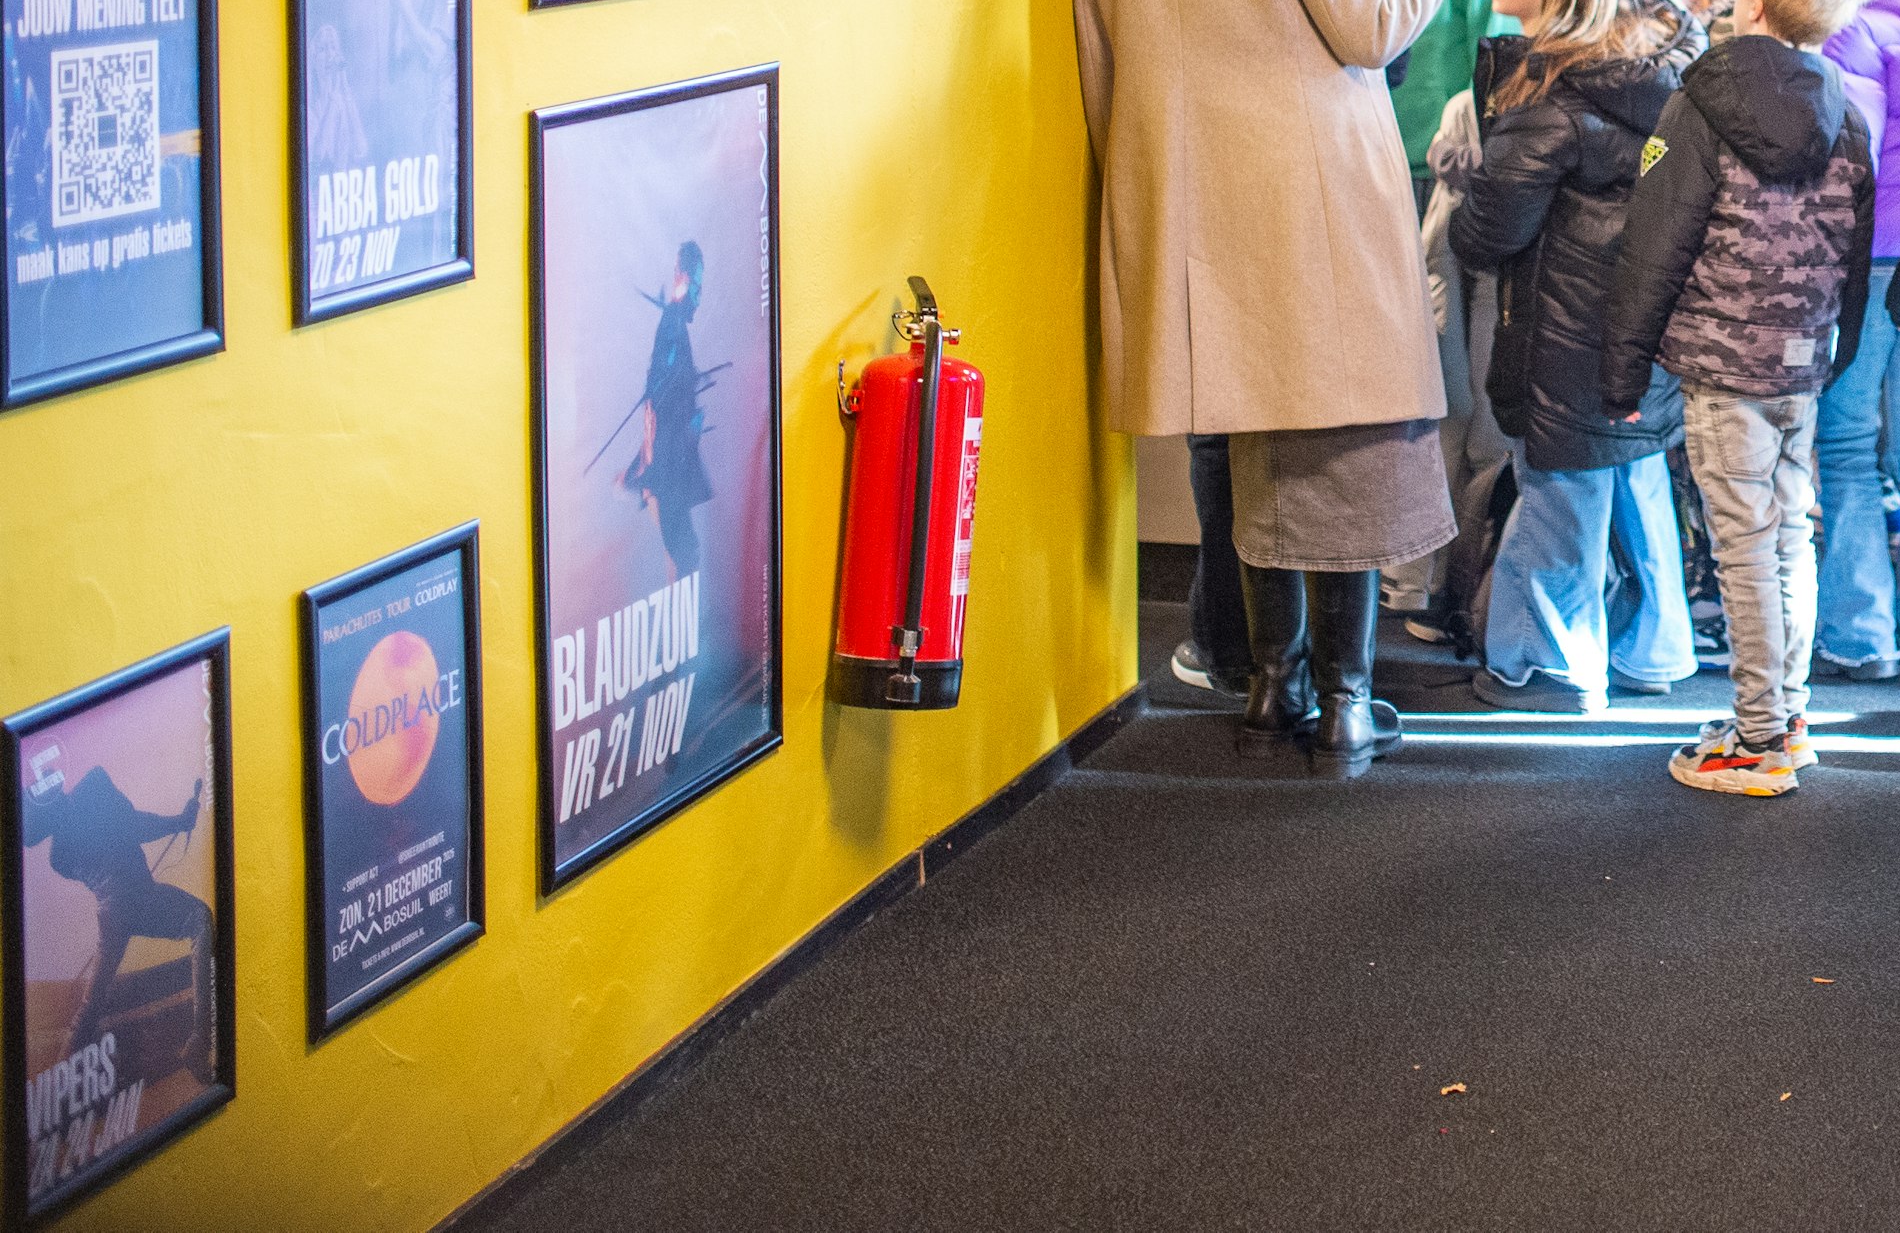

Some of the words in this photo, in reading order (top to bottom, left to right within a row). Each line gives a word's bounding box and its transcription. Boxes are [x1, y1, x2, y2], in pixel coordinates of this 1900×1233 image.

[757, 88, 768, 124] DE
[316, 165, 378, 239] ABBA
[384, 153, 439, 224] GOLD
[17, 243, 54, 284] maak
[58, 241, 90, 275] kans
[93, 238, 110, 271] op
[112, 226, 150, 268] gratis
[152, 219, 192, 255] tickets
[311, 240, 336, 291] ZO
[334, 234, 362, 285] 23
[360, 226, 401, 278] NOV
[760, 215, 770, 317] BOSUIL
[322, 608, 382, 645] PARACHUTES
[385, 596, 412, 618] TOUR
[414, 577, 458, 607] COLDPLAY
[553, 570, 700, 732] BLAUDZUN
[322, 668, 461, 765] COLDPLACE
[559, 729, 602, 825] VR
[598, 707, 636, 800] 21
[635, 673, 696, 777] NOV
[332, 939, 348, 963] DE
[383, 897, 424, 933] BOSUIL
[428, 879, 453, 907] WEERT
[338, 899, 365, 934] ZON.
[367, 888, 382, 917] 21
[384, 855, 443, 909] DECEMBER
[26, 1031, 117, 1143] VIPERS
